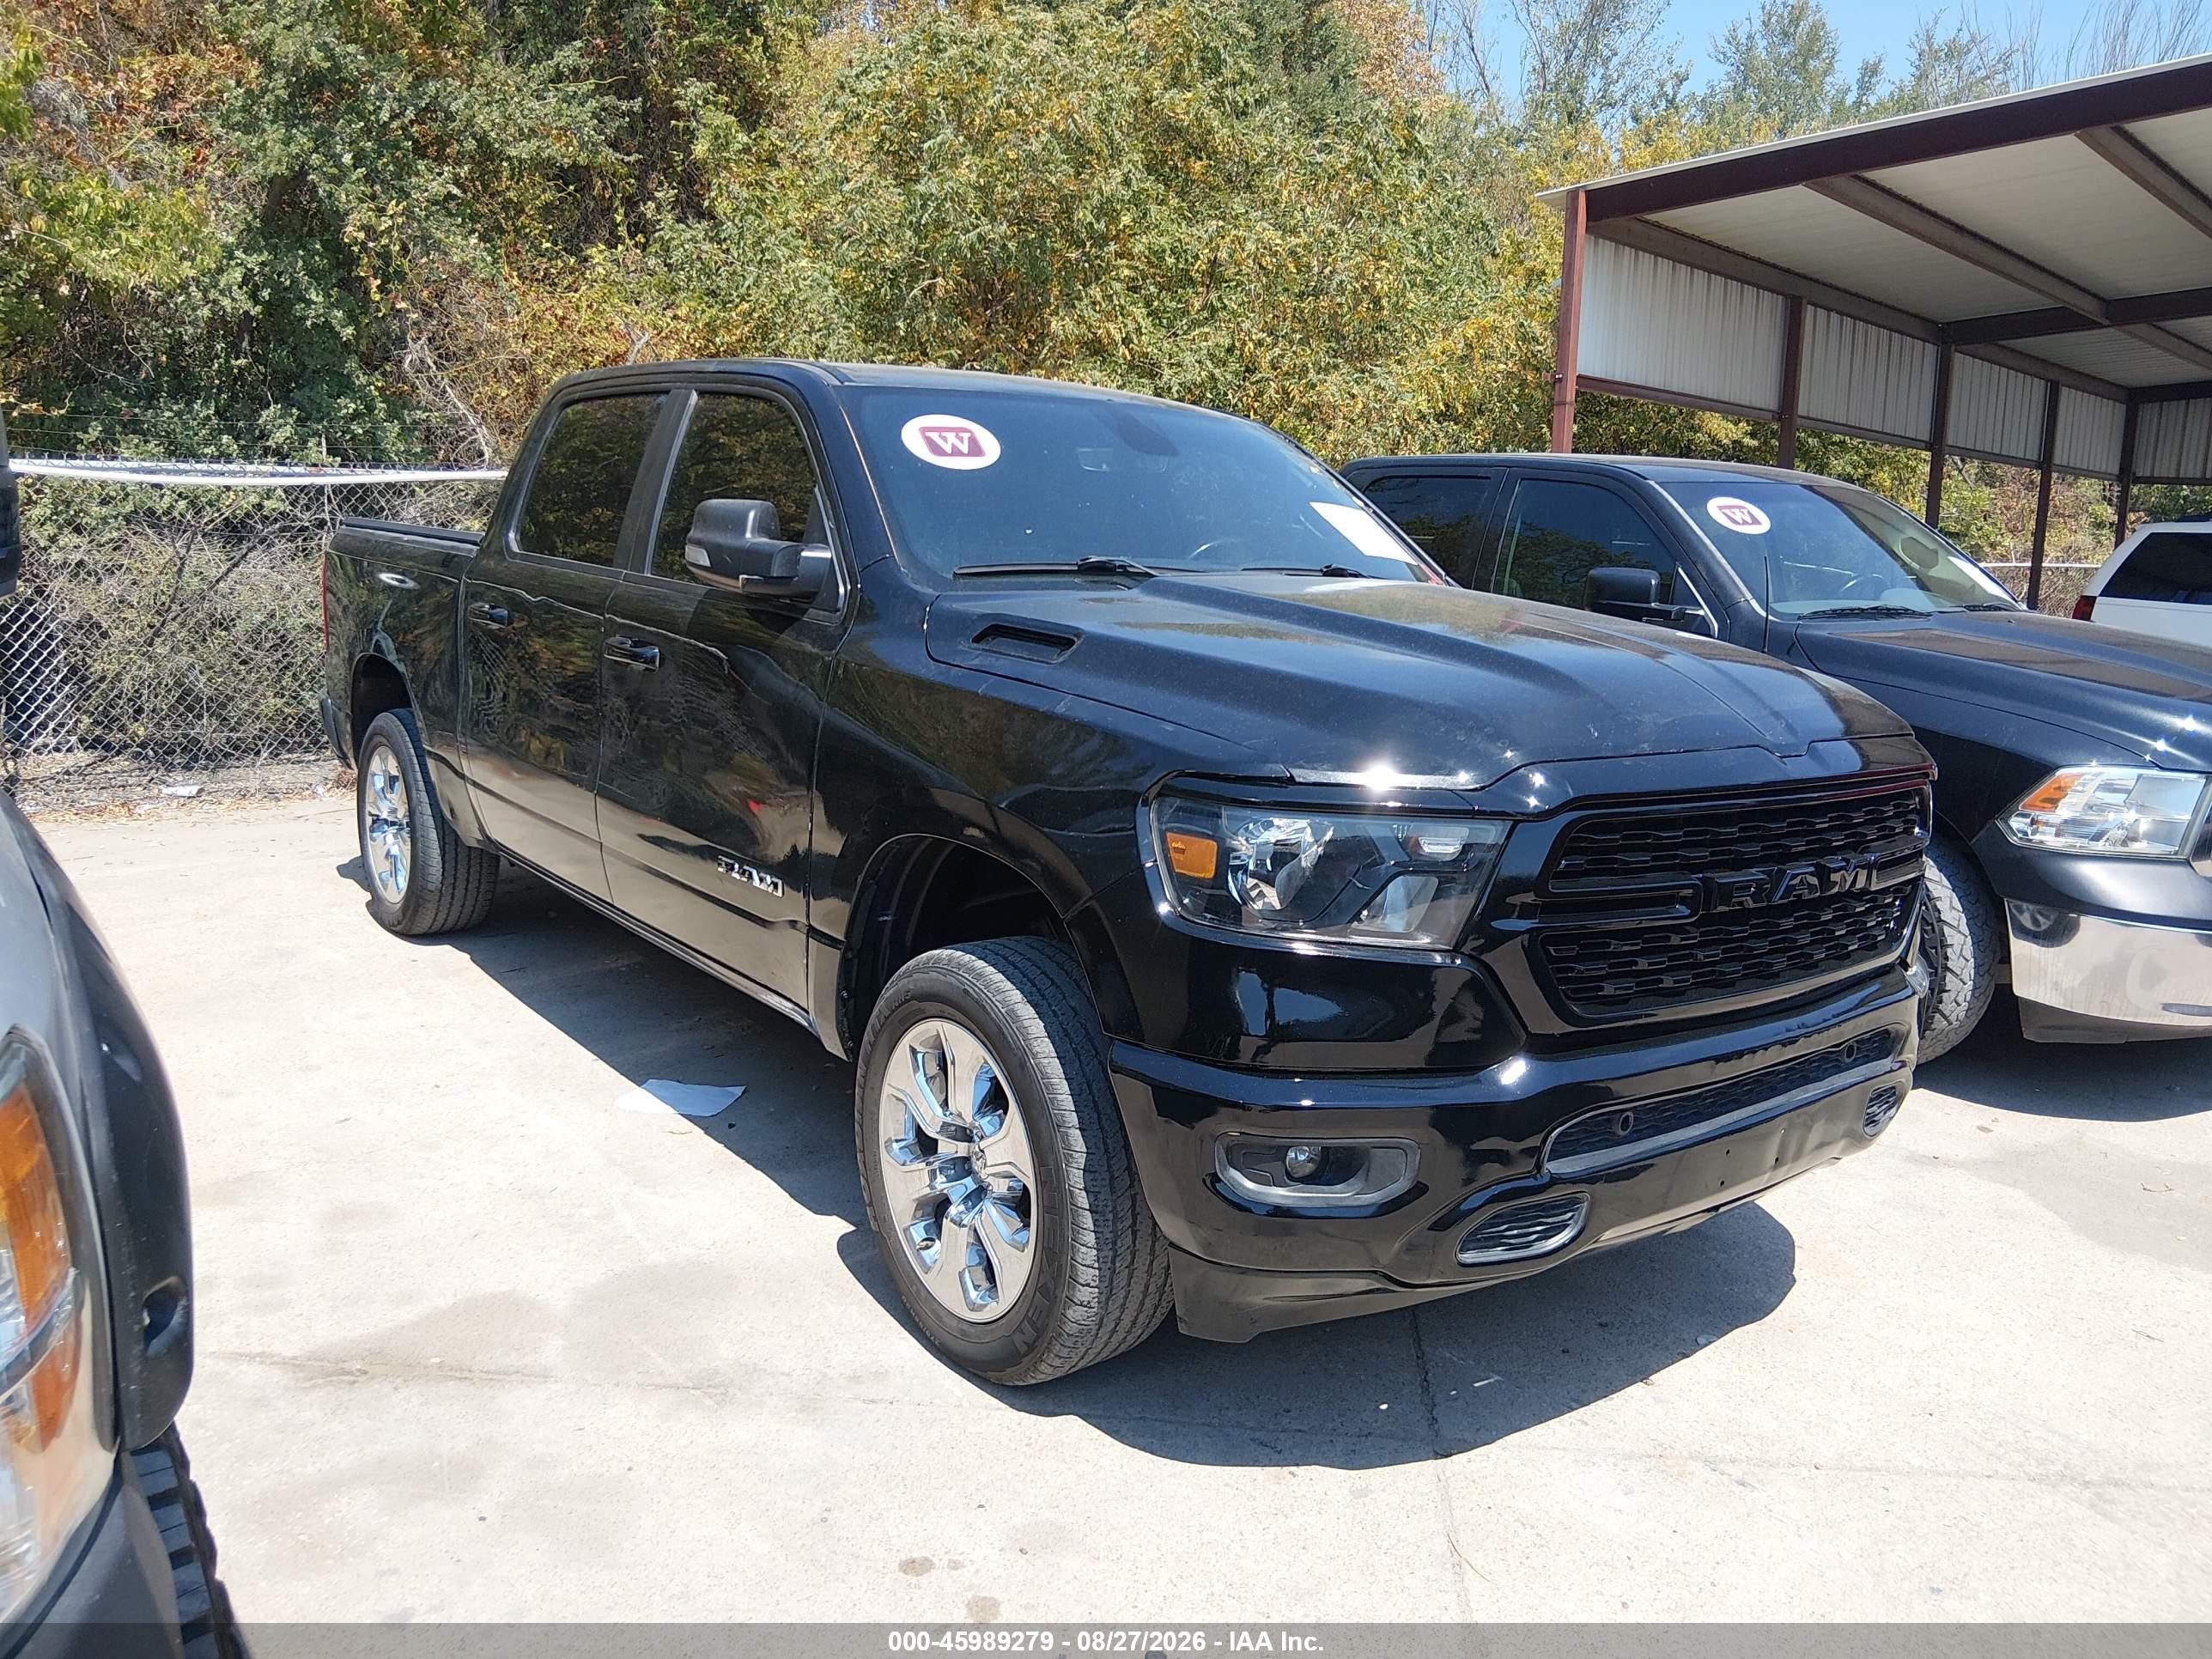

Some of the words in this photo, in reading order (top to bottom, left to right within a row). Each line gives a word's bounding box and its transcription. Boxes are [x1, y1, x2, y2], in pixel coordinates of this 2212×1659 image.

[924, 431, 971, 454] W
[1720, 508, 1753, 524] W
[717, 855, 784, 898] RAM
[1707, 856, 1872, 913] RAM
